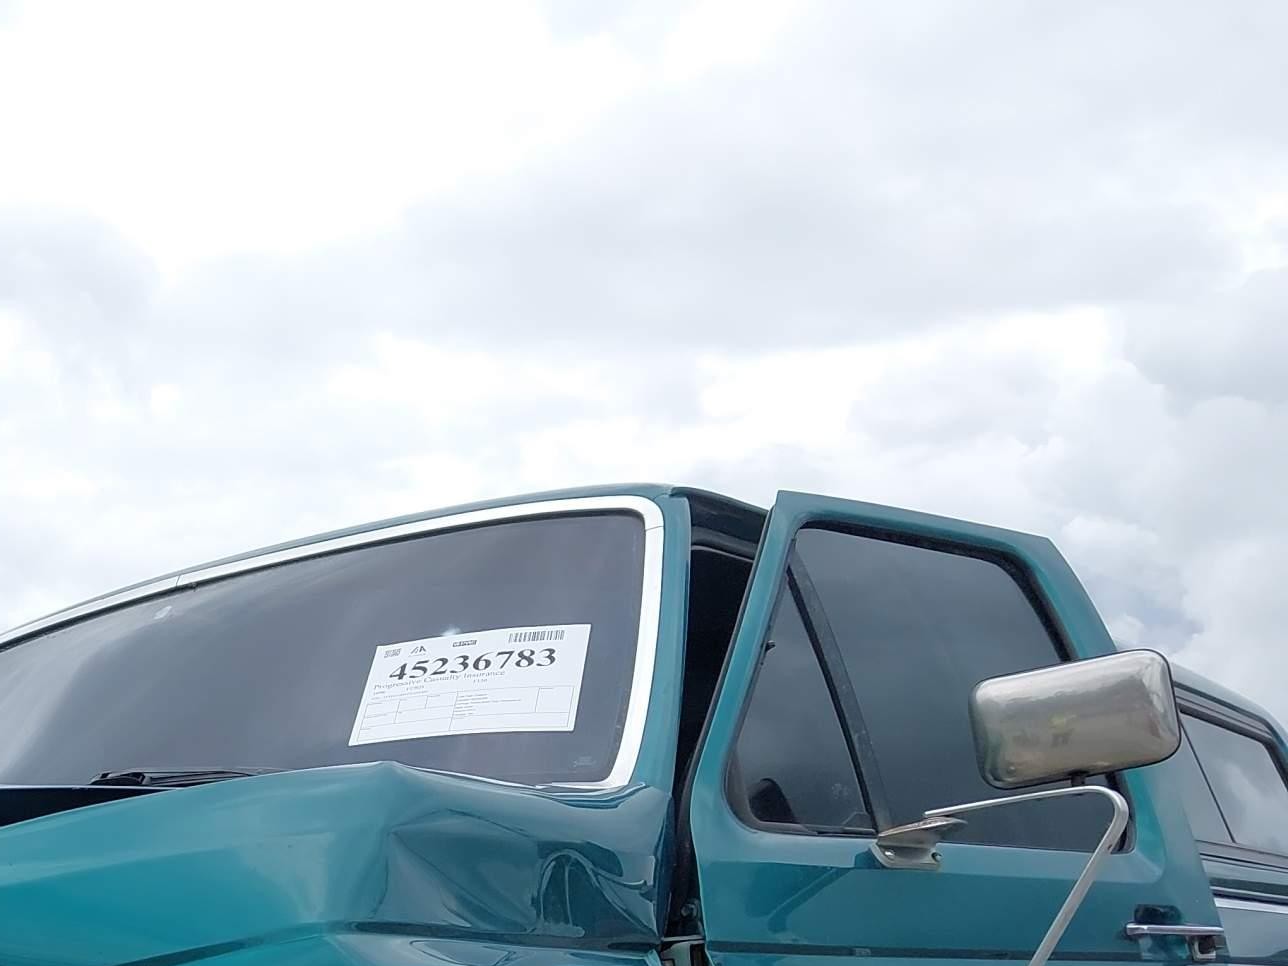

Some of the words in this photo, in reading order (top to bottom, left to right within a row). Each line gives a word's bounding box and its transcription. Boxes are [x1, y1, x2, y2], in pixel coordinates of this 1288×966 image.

[389, 647, 558, 681] 45236783
[373, 680, 422, 691] Progressive
[423, 674, 461, 683] Casualty
[463, 669, 506, 679] Insurance
